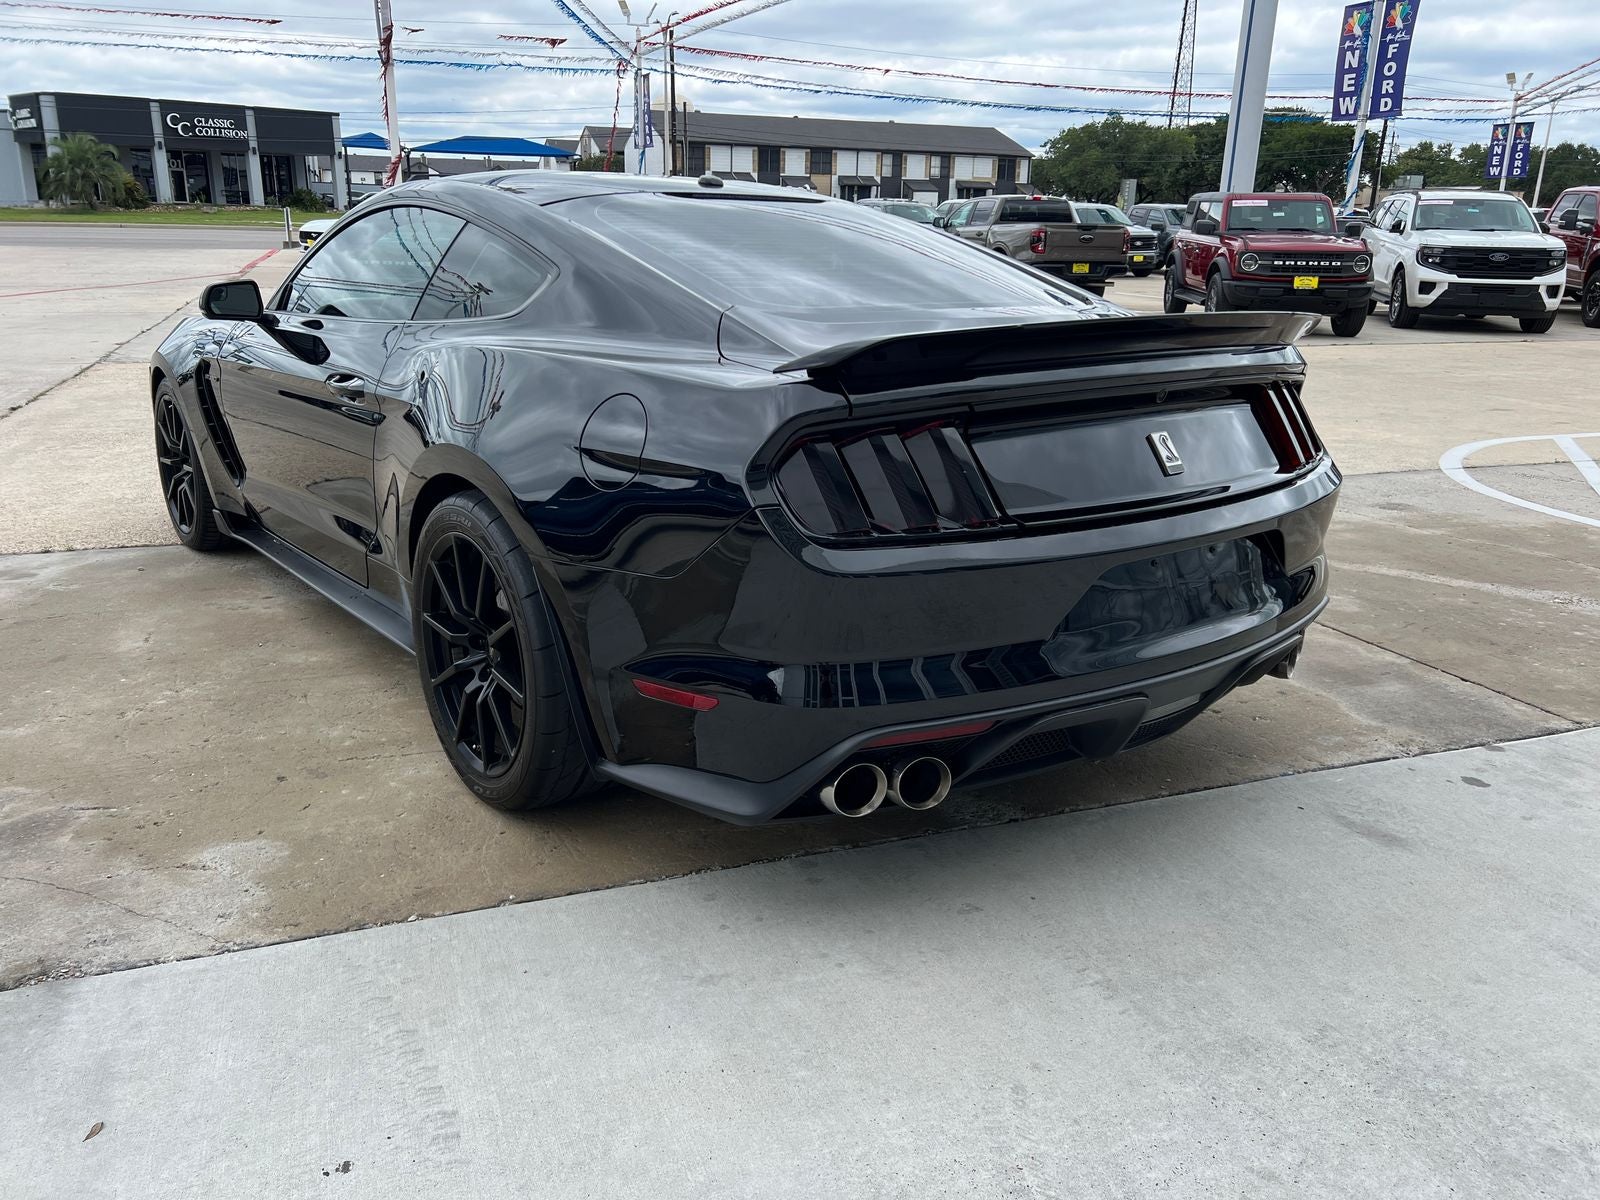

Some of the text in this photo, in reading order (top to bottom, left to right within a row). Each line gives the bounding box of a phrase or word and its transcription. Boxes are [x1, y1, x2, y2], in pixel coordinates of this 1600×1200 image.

[1339, 49, 1361, 115] NEW
[1379, 43, 1400, 112] FORD
[194, 117, 235, 129] CLASSIC
[195, 127, 248, 139] COLLISION
[1489, 145, 1503, 176] NEW
[1512, 143, 1524, 176] FORD
